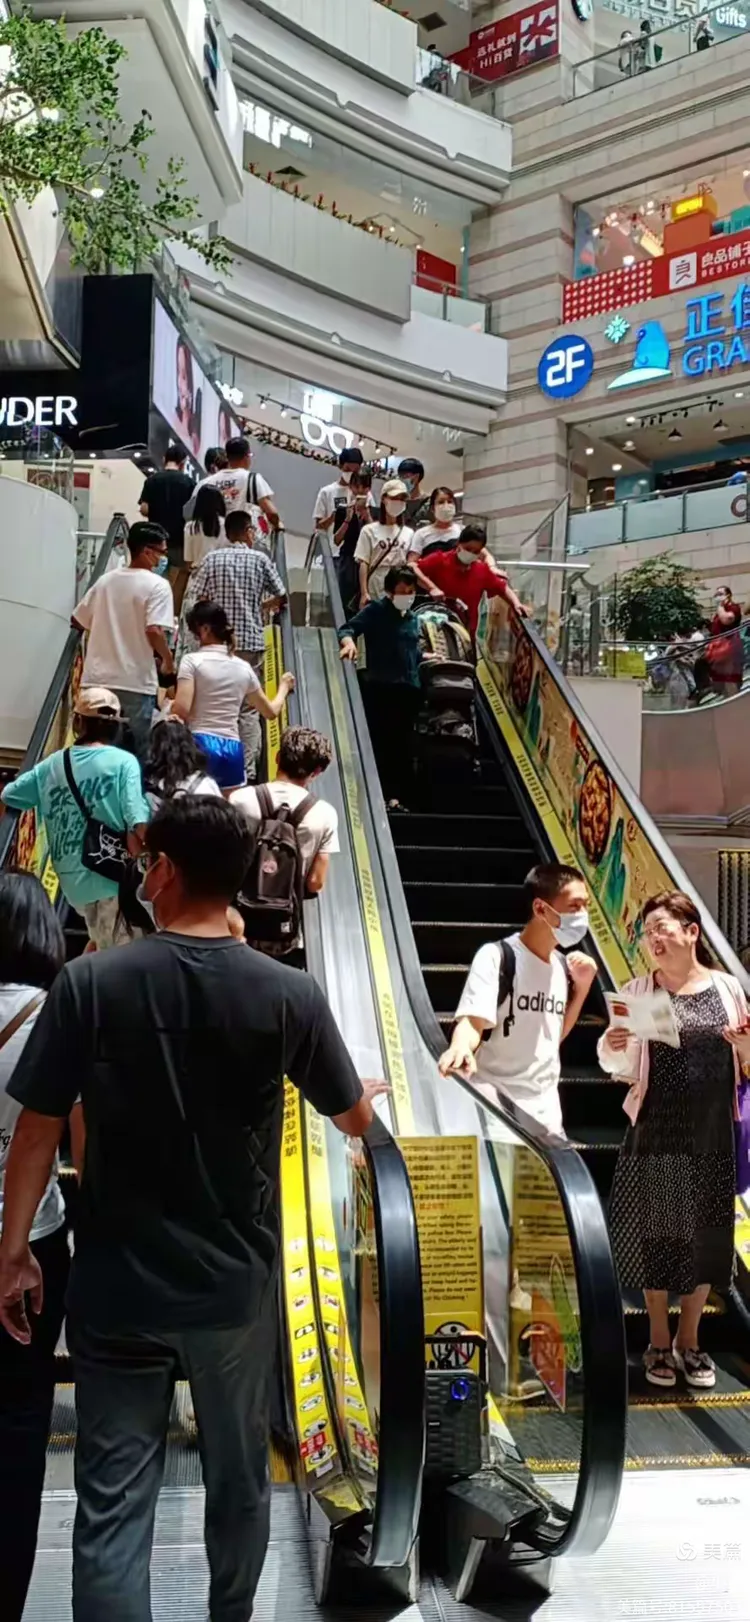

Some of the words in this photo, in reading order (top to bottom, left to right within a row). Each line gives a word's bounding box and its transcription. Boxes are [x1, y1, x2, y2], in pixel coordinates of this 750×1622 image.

[715, 7, 747, 28] Gifts
[546, 344, 586, 387] 2F
[682, 336, 750, 377] GRA
[0, 395, 78, 426] DER
